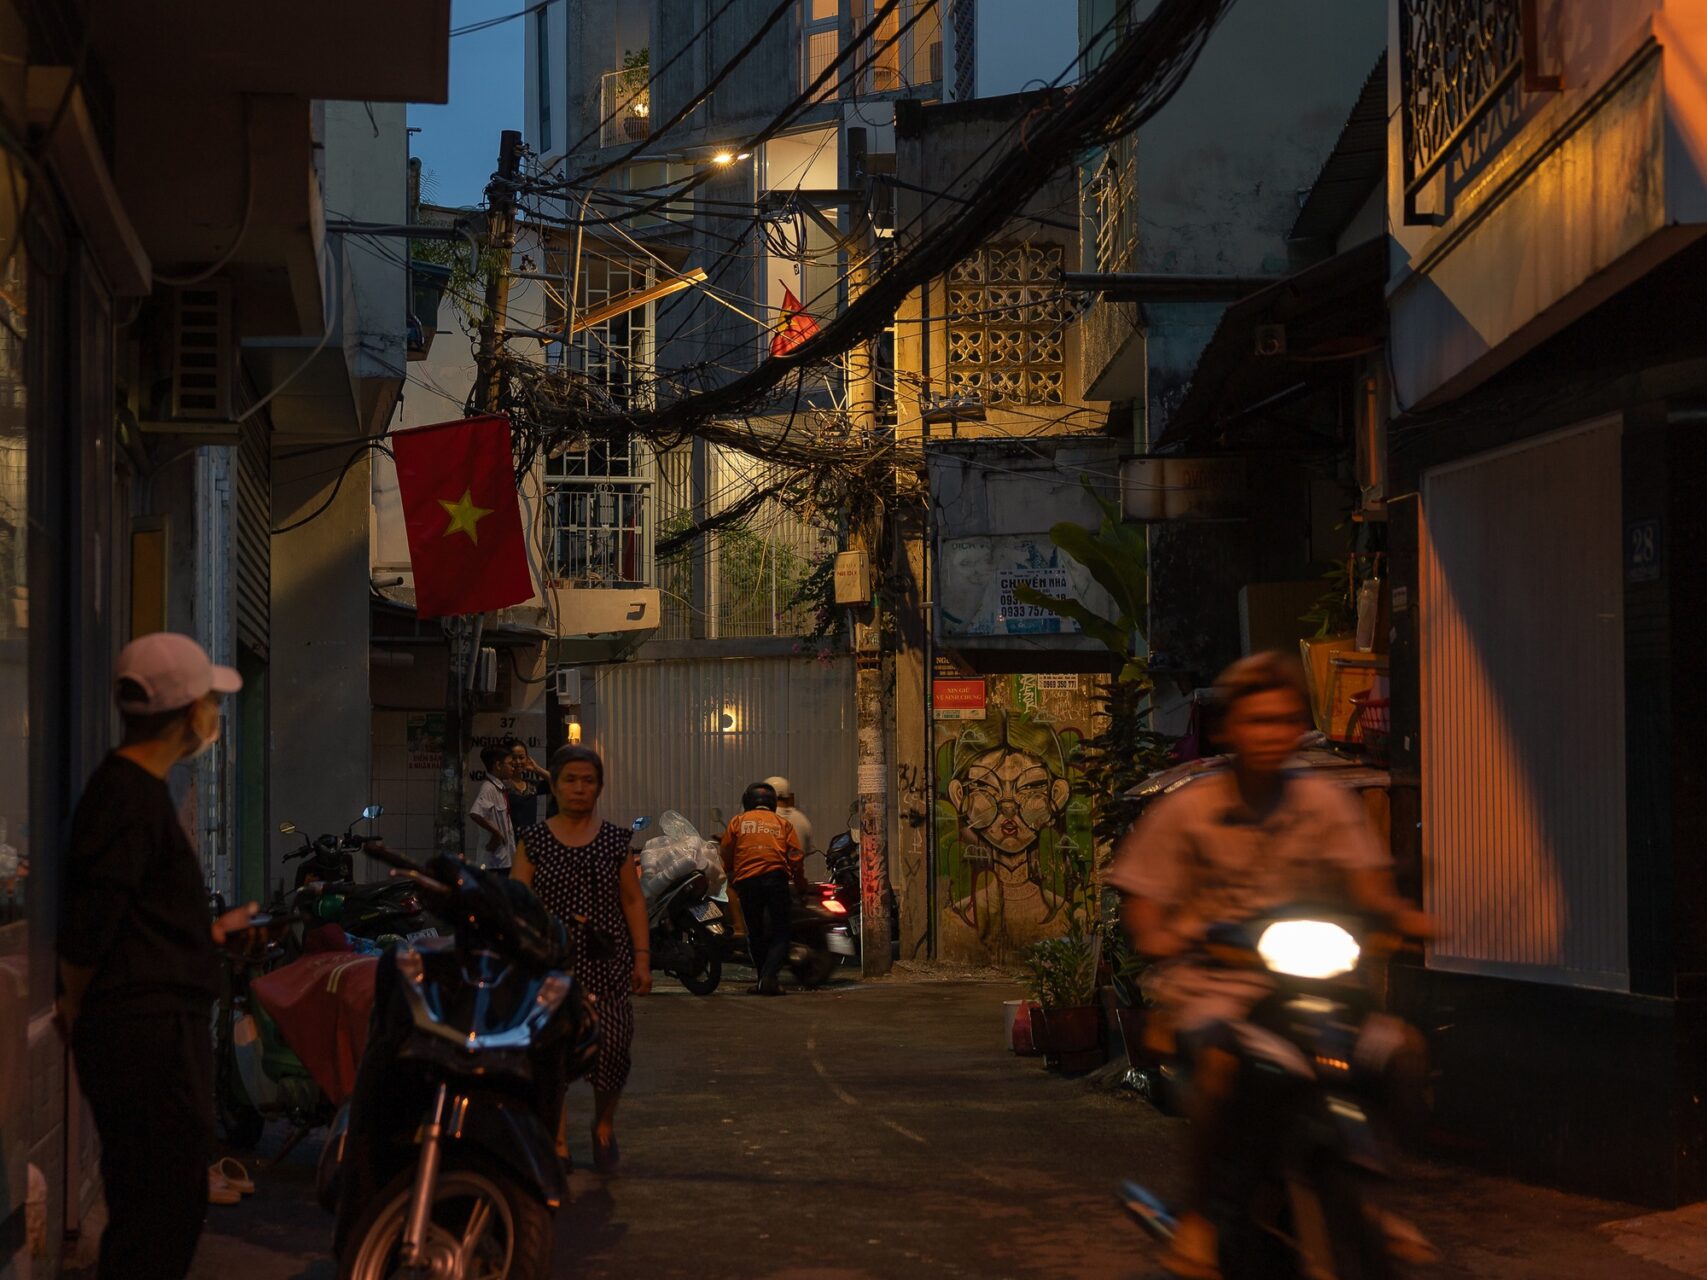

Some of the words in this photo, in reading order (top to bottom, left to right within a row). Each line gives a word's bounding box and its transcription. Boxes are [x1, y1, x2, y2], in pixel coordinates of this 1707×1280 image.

[1632, 525, 1655, 562] 28
[1000, 595, 1023, 605] 093
[1001, 606, 1025, 617] 0933
[500, 718, 515, 728] 37
[757, 826, 781, 837] Food
